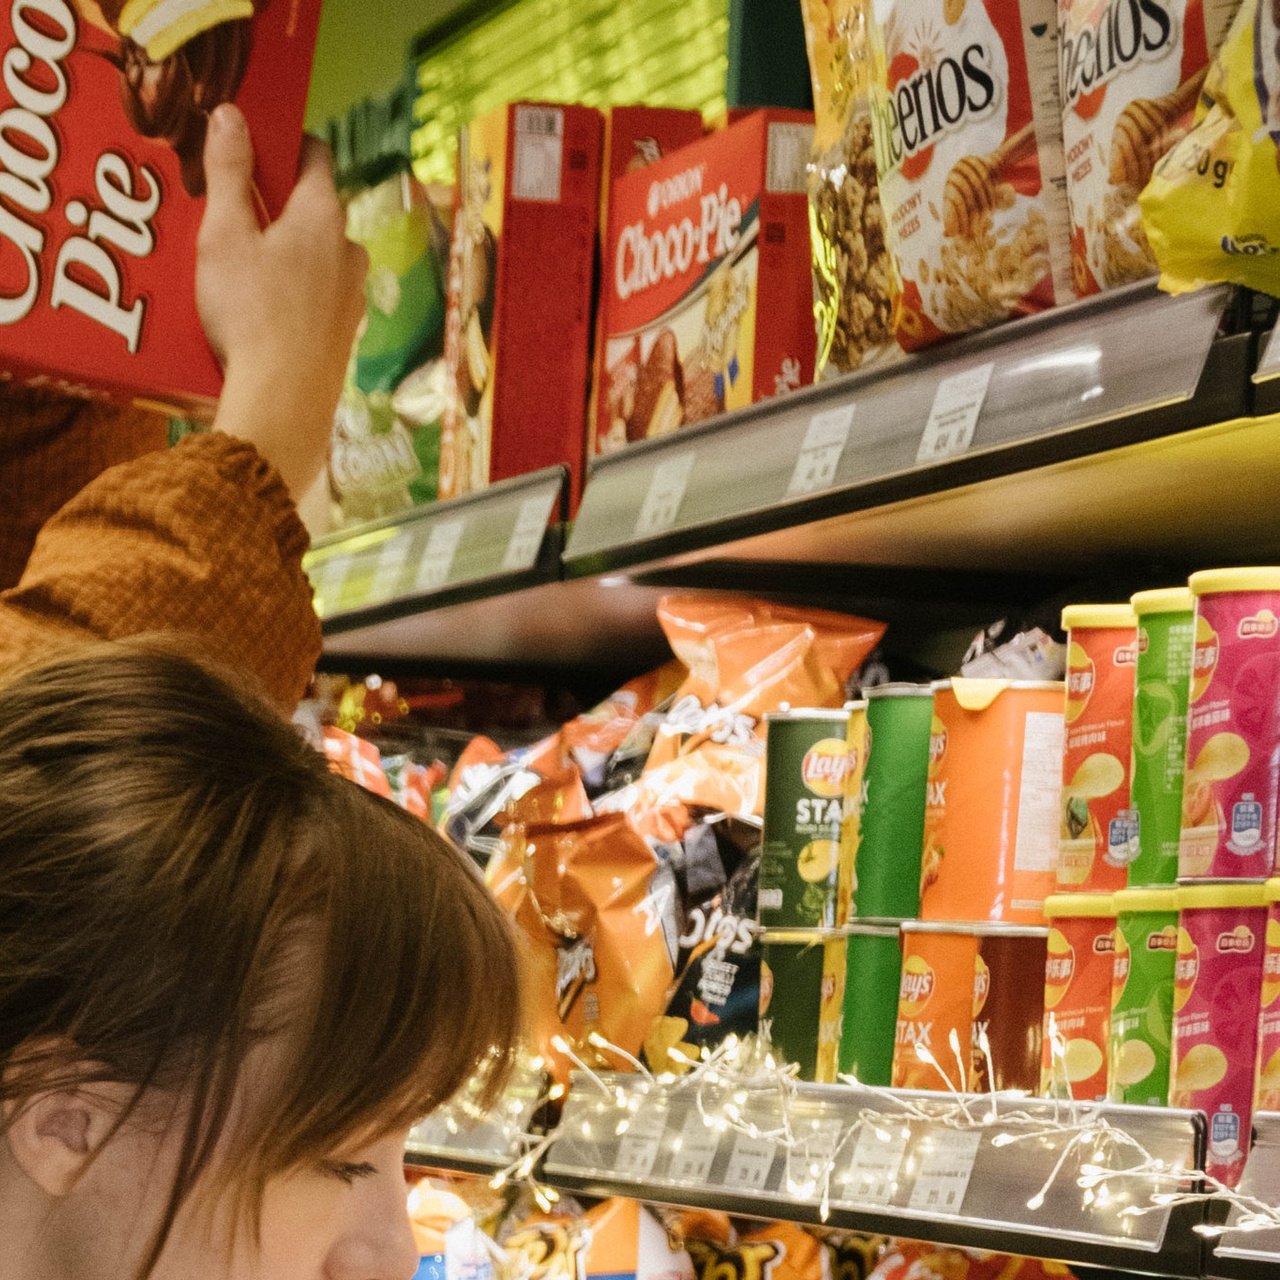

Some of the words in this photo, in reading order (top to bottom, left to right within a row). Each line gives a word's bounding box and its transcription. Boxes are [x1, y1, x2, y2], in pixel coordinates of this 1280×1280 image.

[51, 152, 162, 353] Pie
[926, 781, 947, 807] AX
[796, 798, 844, 824] STA
[896, 1019, 933, 1047] TAX
